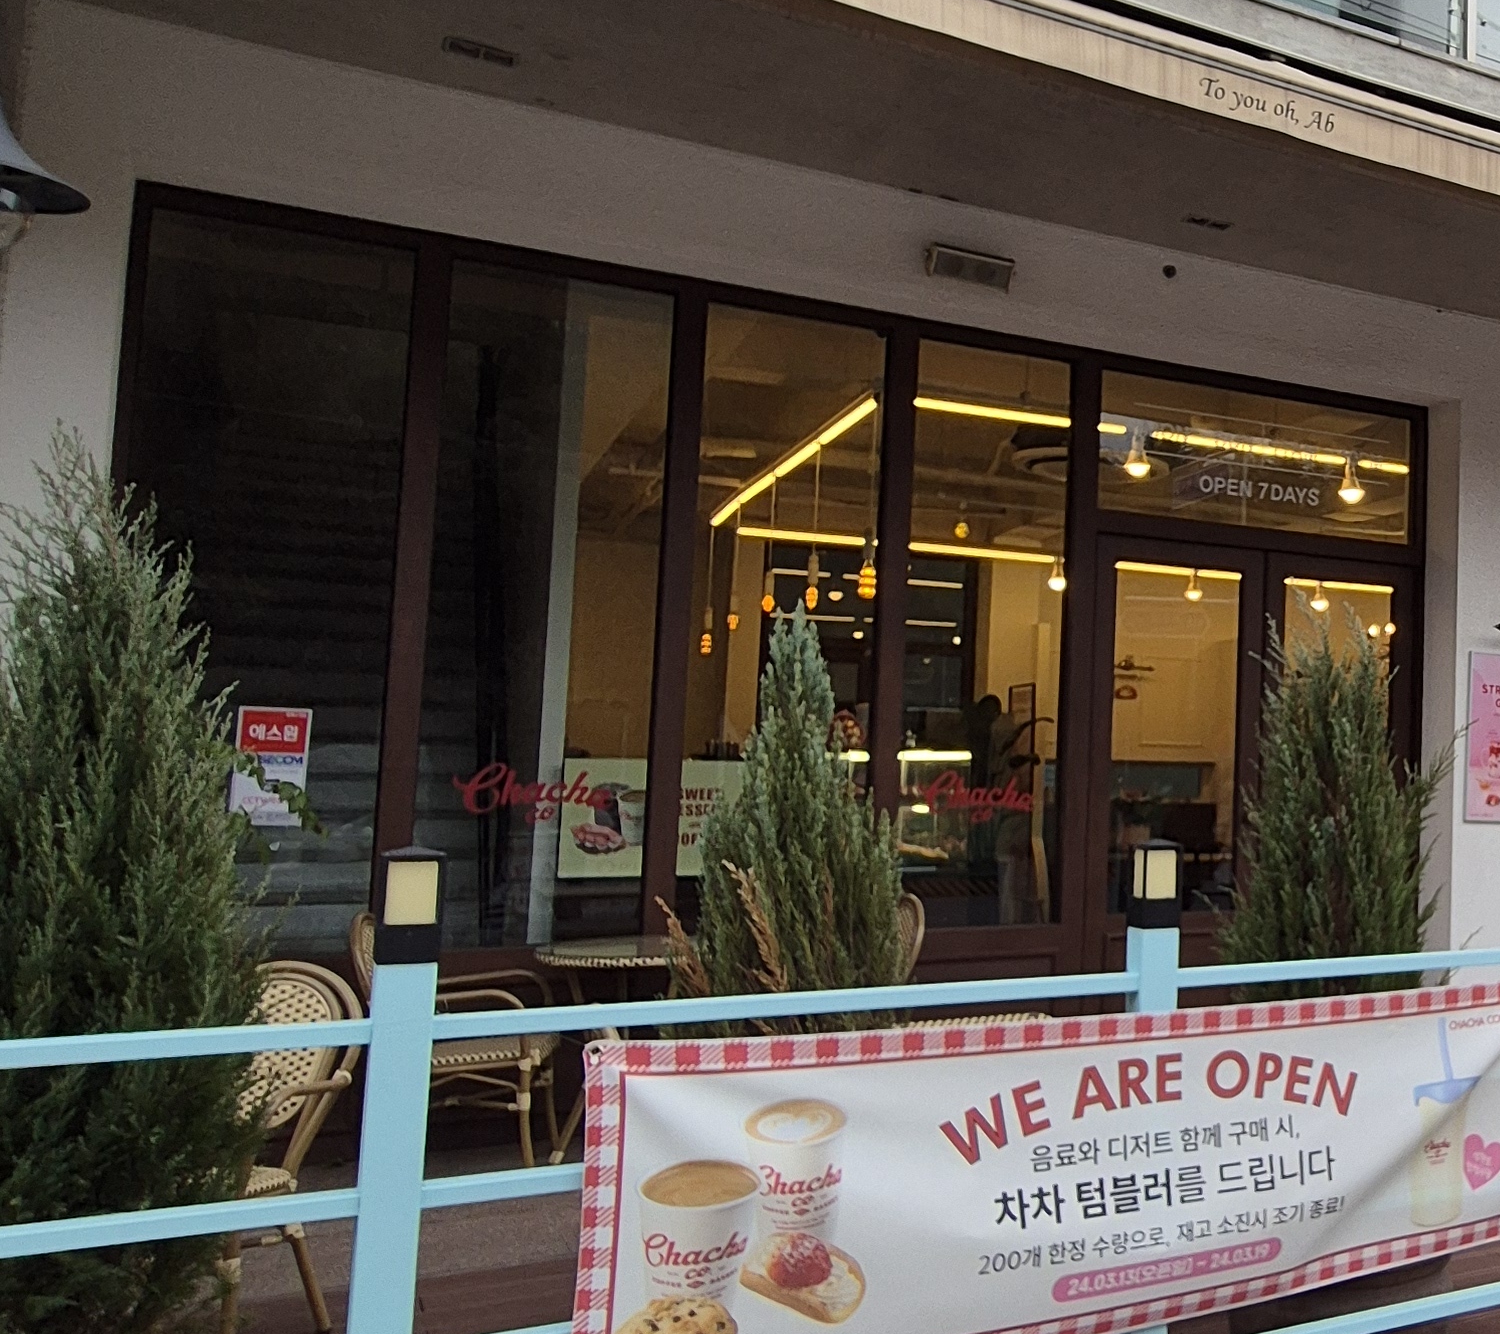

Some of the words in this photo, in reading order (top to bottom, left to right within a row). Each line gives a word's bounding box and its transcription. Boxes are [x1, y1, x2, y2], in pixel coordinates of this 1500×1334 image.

[1199, 76, 1226, 101] To
[1229, 90, 1267, 113] you
[1304, 109, 1336, 134] Ab
[1199, 474, 1252, 499] OPEN
[248, 723, 299, 743] 에스원
[938, 1079, 1053, 1166] WE
[1071, 1052, 1184, 1120] ARE
[1206, 1049, 1359, 1117] OPEN
[1030, 1137, 1101, 1173] 음료와
[1107, 1130, 1174, 1161] 디저트
[1180, 1122, 1223, 1153] 함께
[1228, 1117, 1270, 1146] 구매
[1275, 1114, 1301, 1140] 시,
[993, 1183, 1067, 1230] 차차
[1075, 1165, 1207, 1220] 텀블러를
[1216, 1145, 1336, 1194] 드립니다
[978, 1244, 1042, 1276] 200개
[1048, 1238, 1088, 1266] 한정
[1091, 1226, 1171, 1258] 수량으로,
[1177, 1219, 1212, 1242] 재고
[1217, 1208, 1268, 1235] 소진시
[1272, 1202, 1305, 1226] 조기
[1308, 1195, 1346, 1219] 종료!
